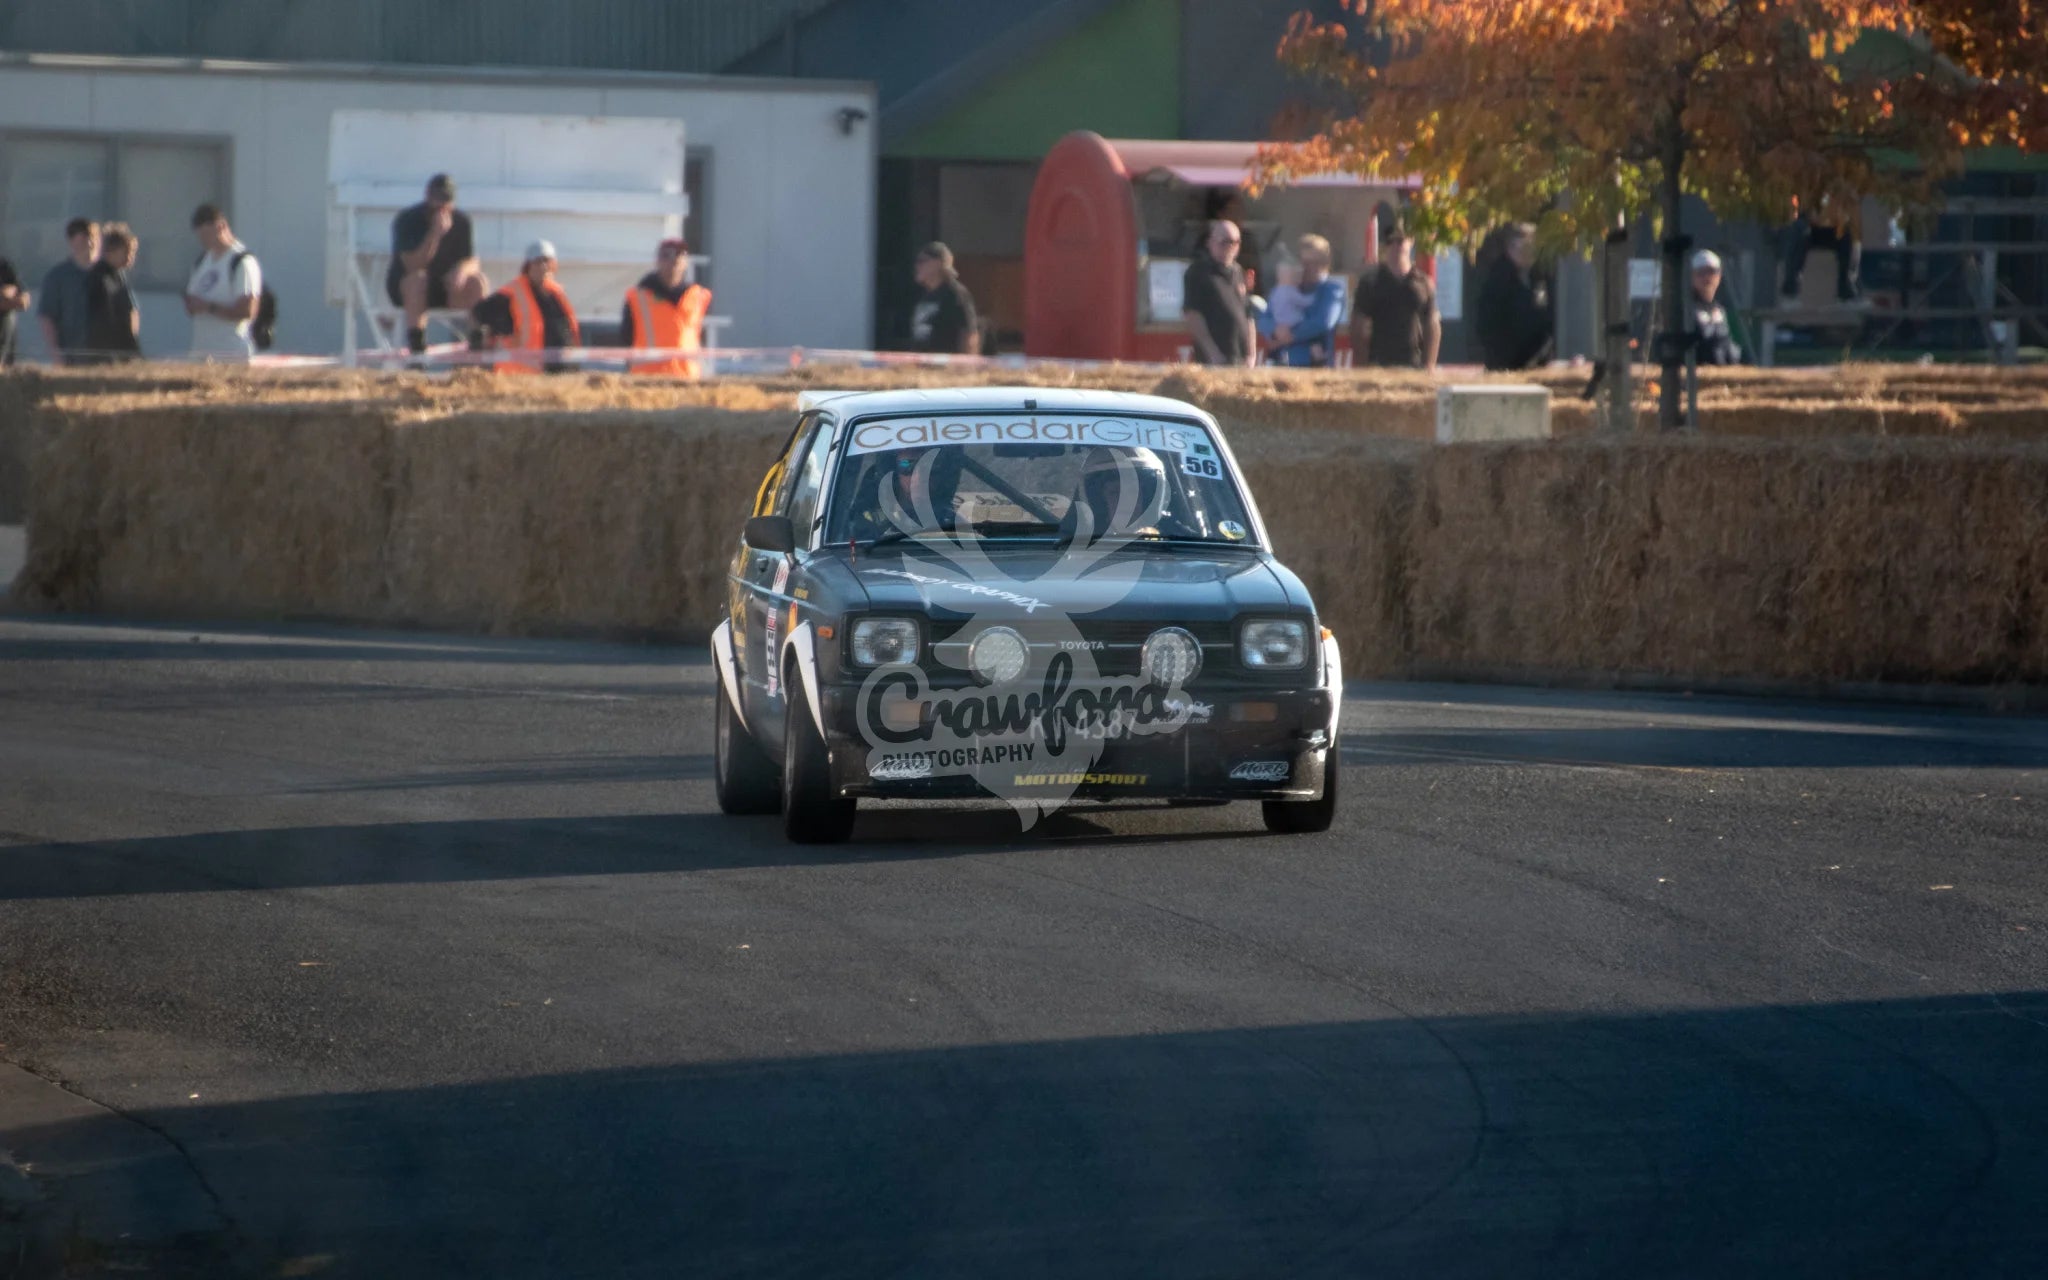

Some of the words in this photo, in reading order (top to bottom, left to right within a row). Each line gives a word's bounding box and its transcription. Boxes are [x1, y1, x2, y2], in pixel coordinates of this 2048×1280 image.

[854, 417, 1187, 449] CalendarGirls
[1186, 456, 1218, 476] 56
[1060, 641, 1105, 650] TOYOTA
[1014, 773, 1148, 786] MOTORSPORT
